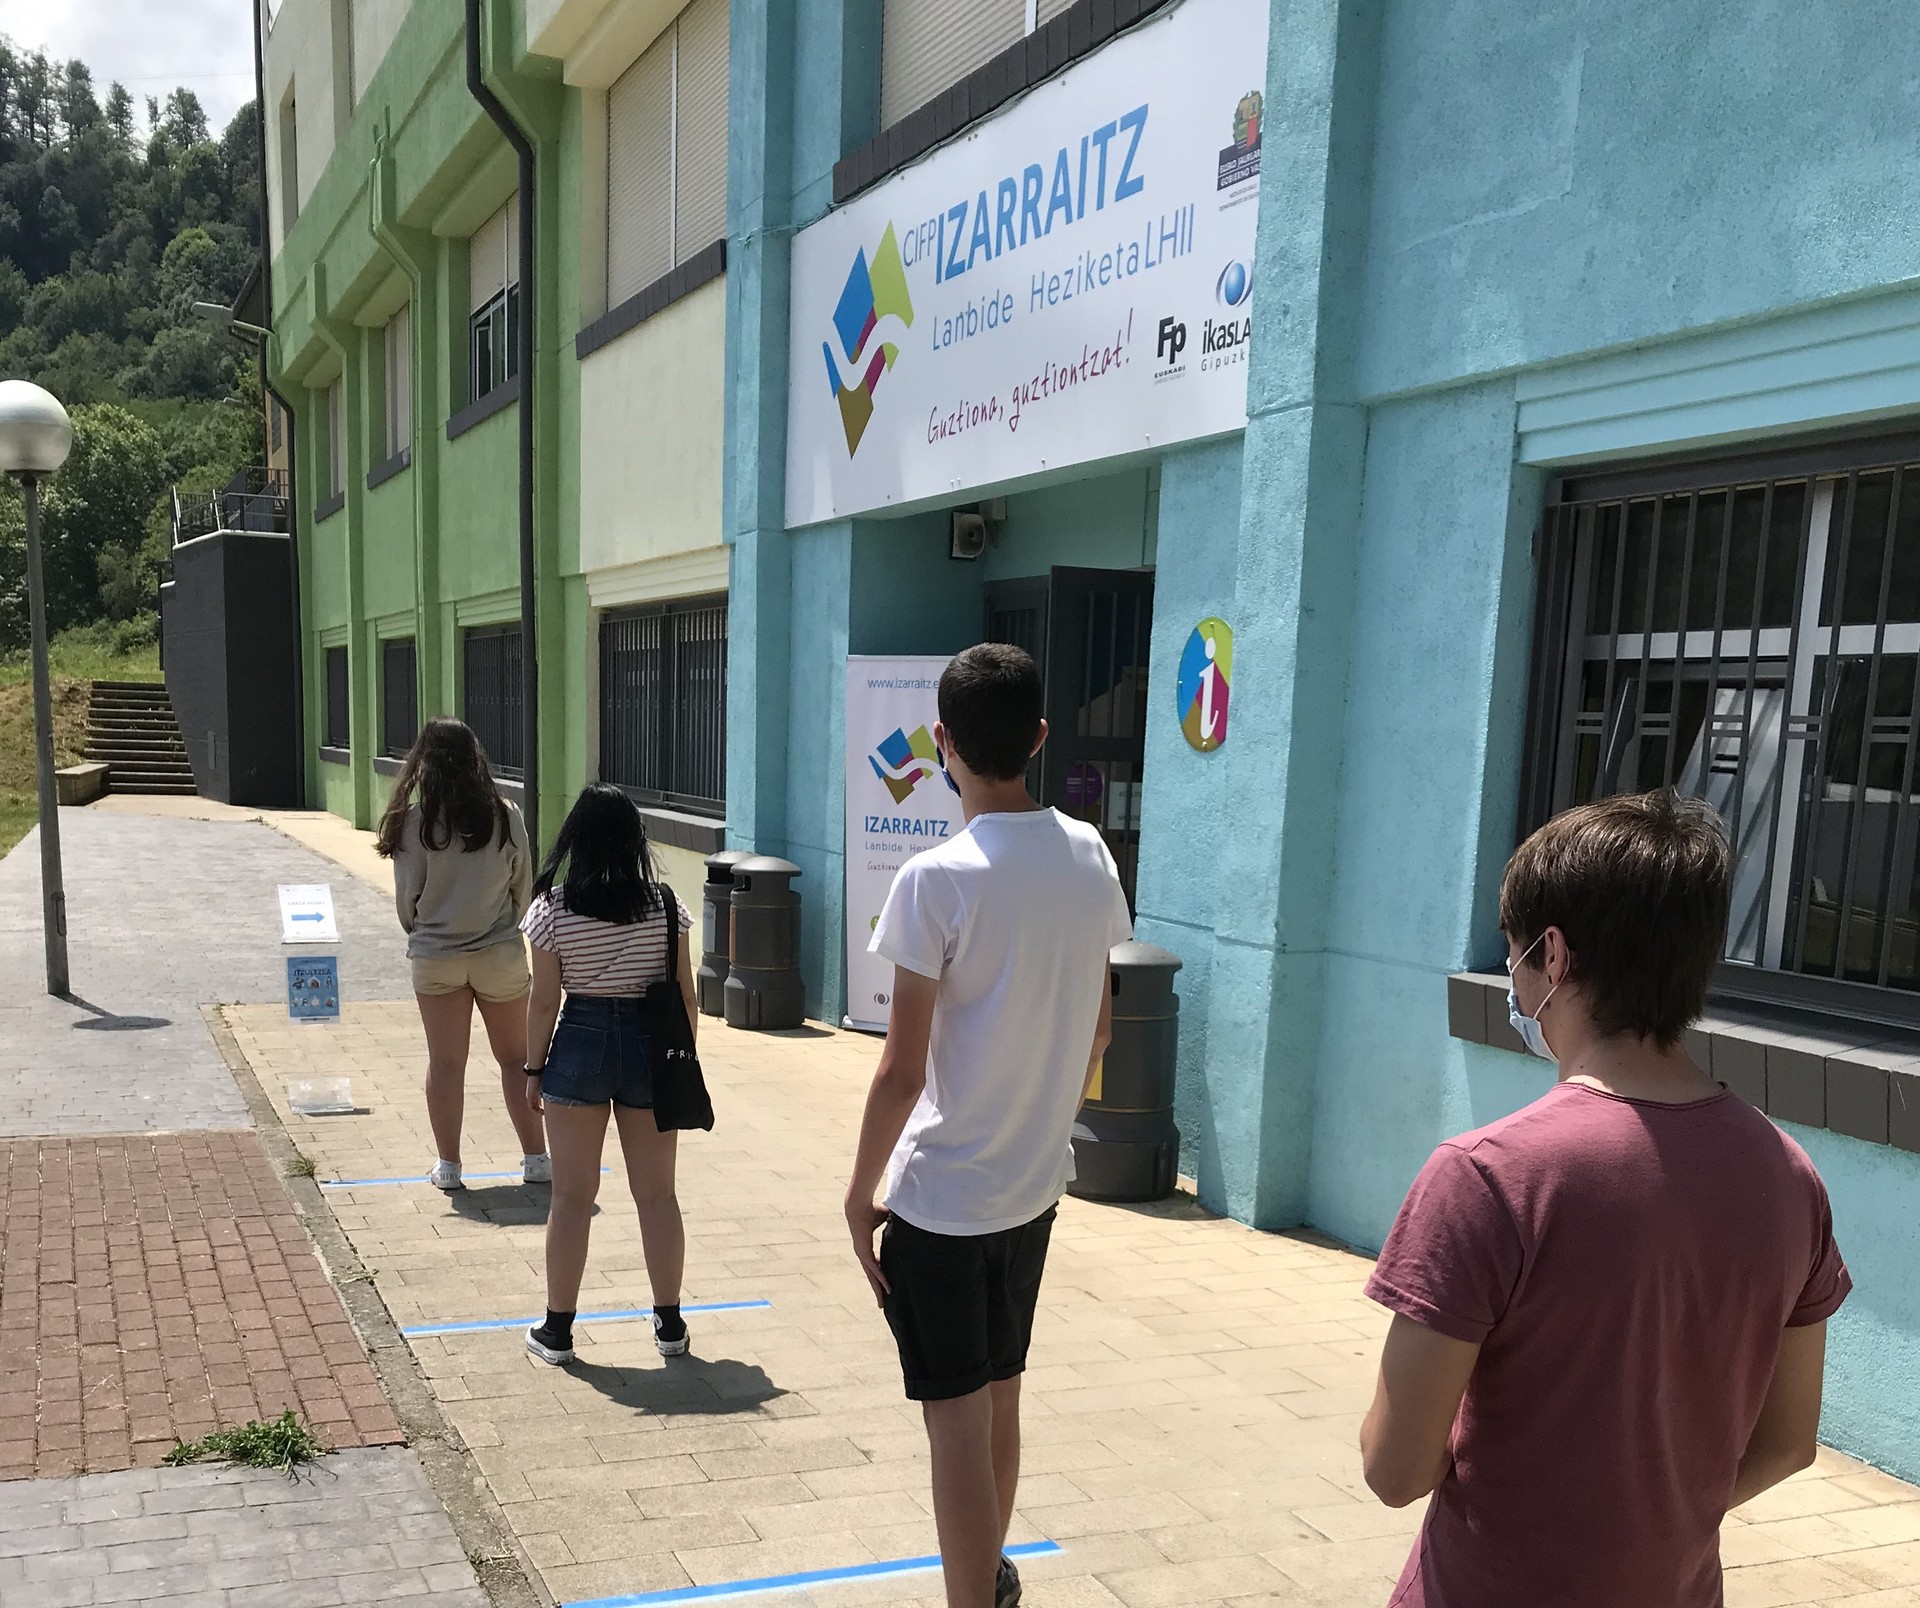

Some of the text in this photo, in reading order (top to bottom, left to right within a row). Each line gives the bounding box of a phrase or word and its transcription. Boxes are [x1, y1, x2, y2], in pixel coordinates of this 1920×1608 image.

[1220, 167, 1250, 187] GOBIERNO
[903, 103, 1149, 285] CIFP IZARRAITZ
[933, 289, 1014, 351] Lanbide
[1030, 241, 1139, 313] Heziketa
[1157, 316, 1187, 365] Fp
[1154, 365, 1186, 379] EUSKADI
[1201, 349, 1245, 372] Gipuzk
[927, 307, 1134, 444] Guztiona, guztiontzat!
[864, 815, 949, 838] IZARRAITZ
[864, 841, 903, 853] Lanbide
